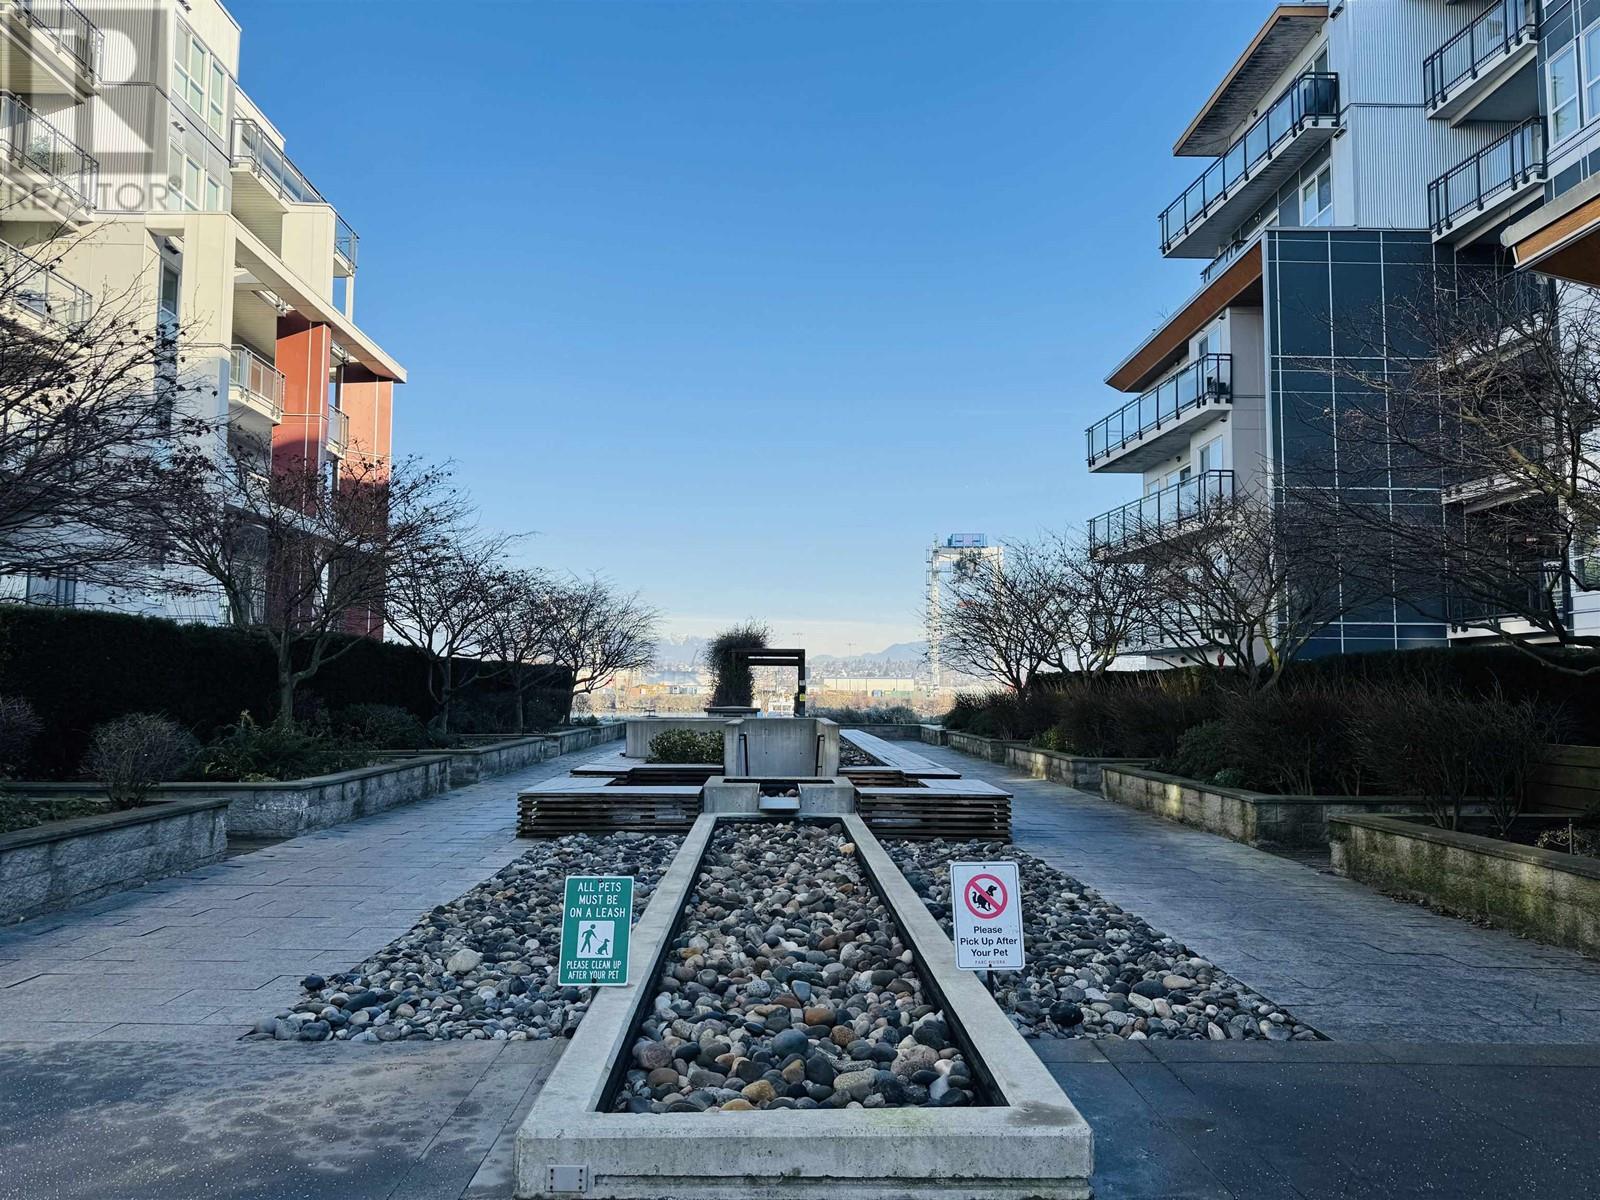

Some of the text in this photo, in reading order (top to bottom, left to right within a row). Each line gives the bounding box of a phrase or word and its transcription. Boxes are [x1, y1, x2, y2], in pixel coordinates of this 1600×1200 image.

[577, 882, 622, 892] ALL PETS
[578, 894, 618, 905] MUST BE
[569, 907, 626, 918] ON A LEASH
[973, 926, 1003, 934] Please
[960, 937, 1018, 947] Pick Up After
[971, 948, 1009, 957] Your Pet
[566, 960, 622, 969] PLEASE CLEAN UP
[567, 970, 620, 980] AFTER YOUR PET
